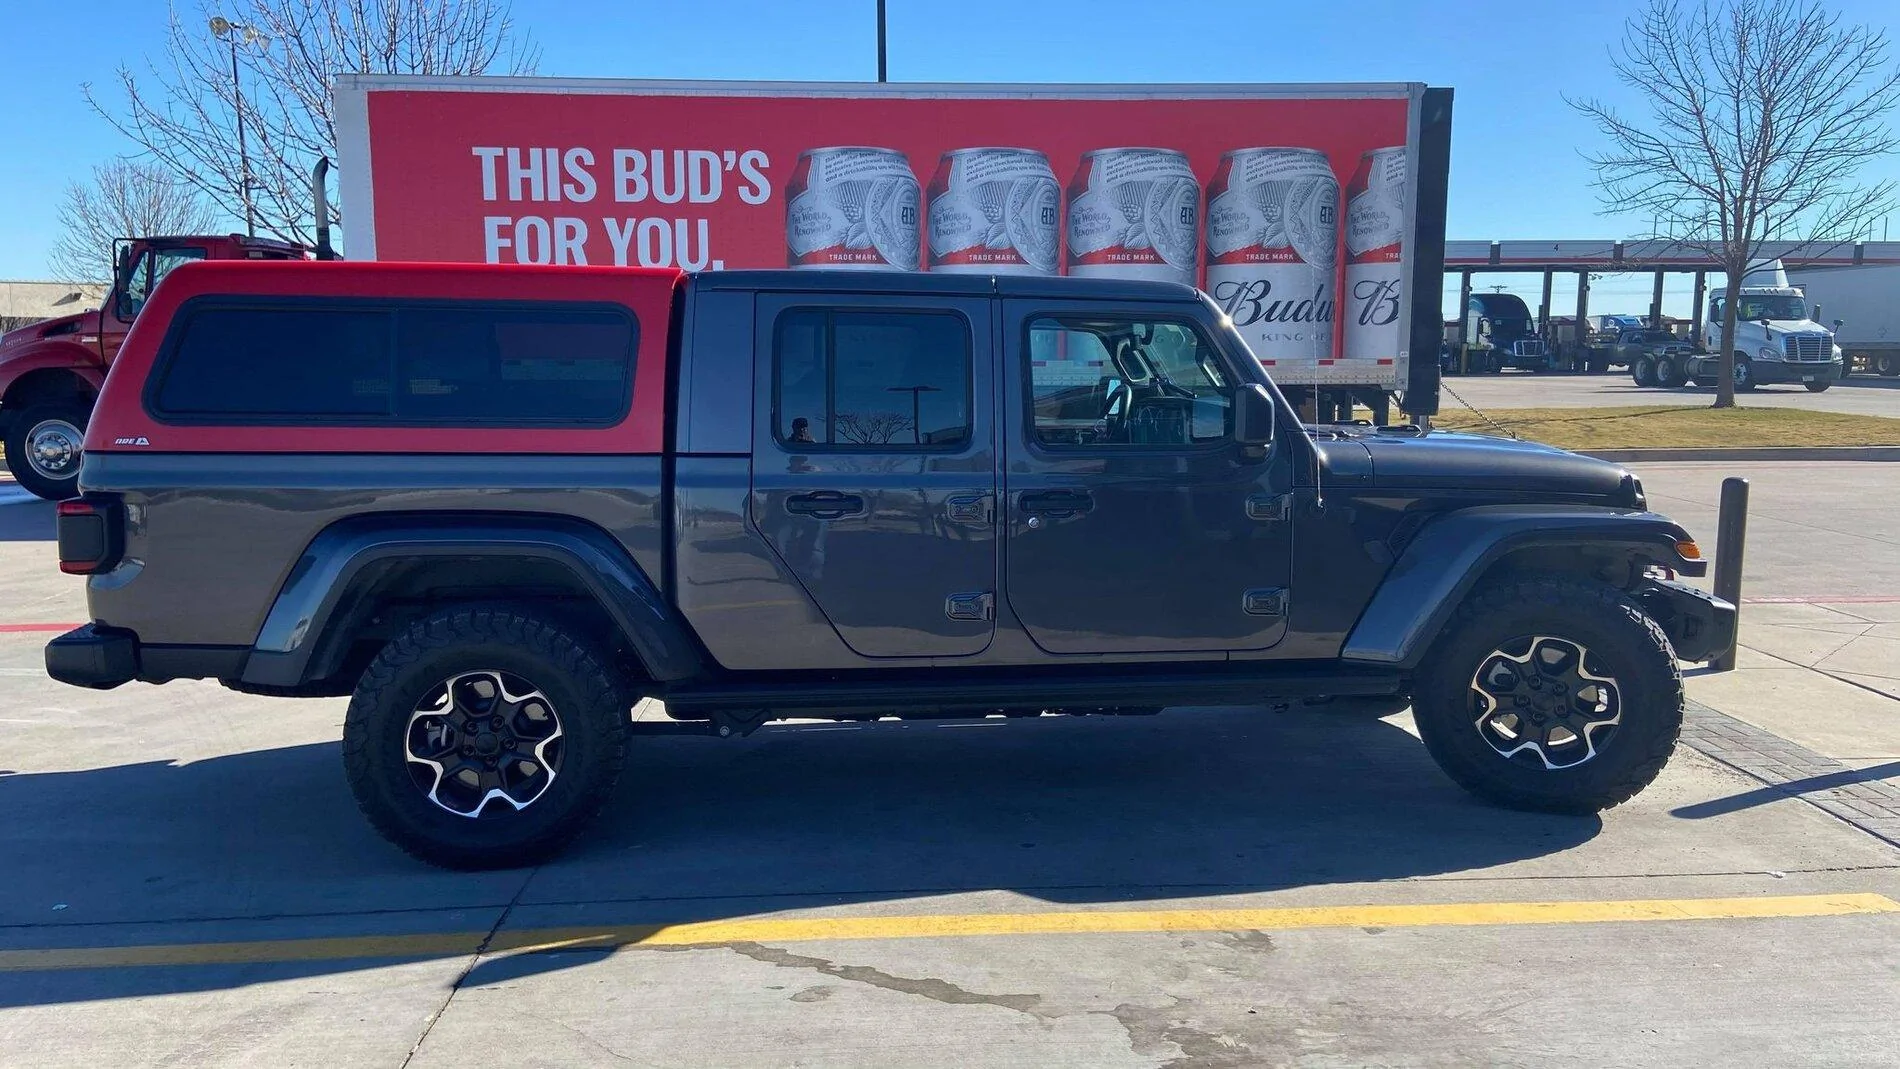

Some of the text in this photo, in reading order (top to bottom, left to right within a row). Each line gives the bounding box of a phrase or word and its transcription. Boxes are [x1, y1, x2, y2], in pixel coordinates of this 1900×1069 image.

[472, 146, 771, 204] THIS BUD'S
[484, 215, 724, 271] FOR YOU.
[1262, 332, 1303, 341] KING
